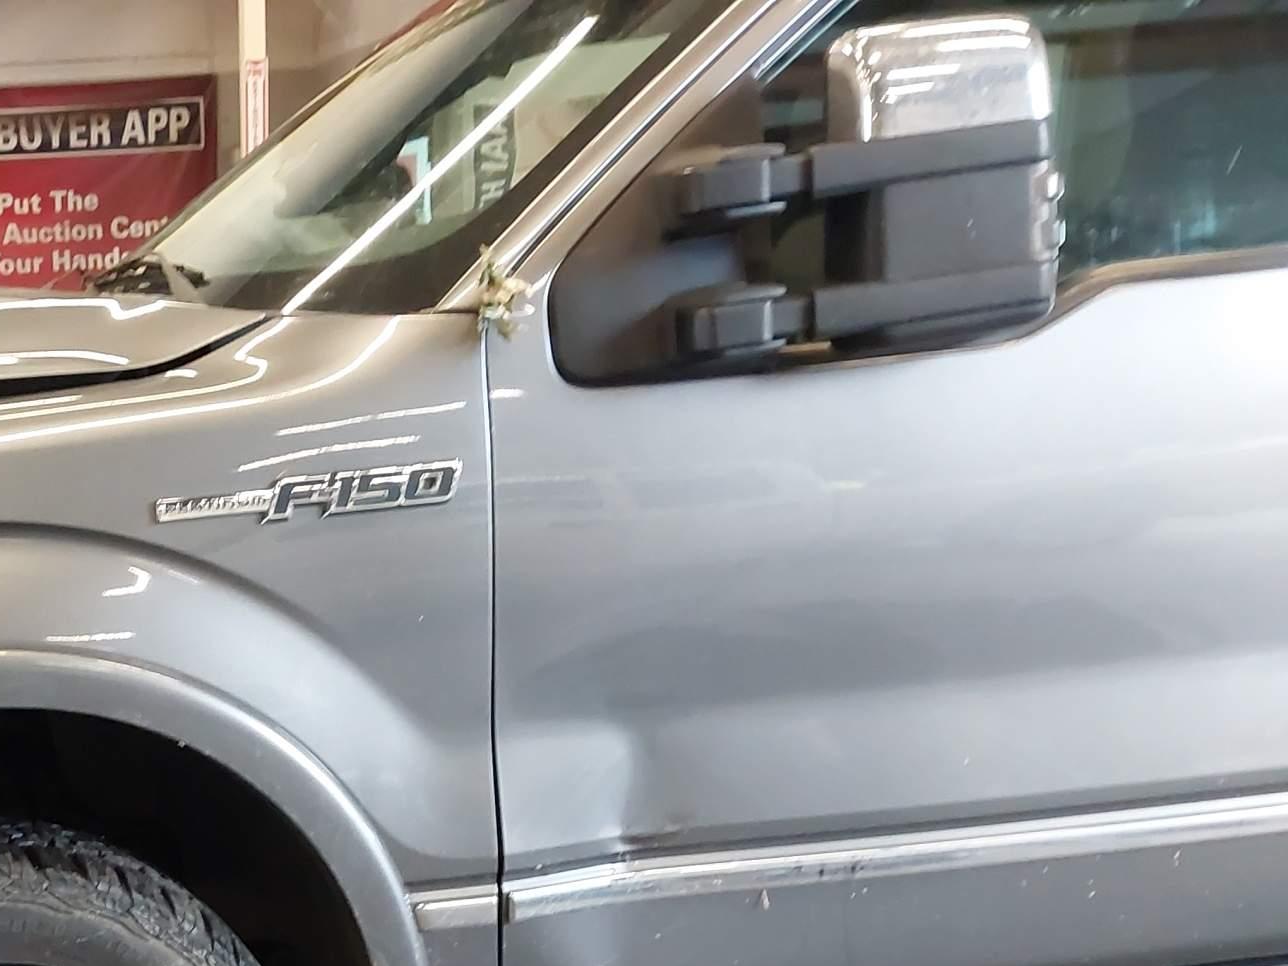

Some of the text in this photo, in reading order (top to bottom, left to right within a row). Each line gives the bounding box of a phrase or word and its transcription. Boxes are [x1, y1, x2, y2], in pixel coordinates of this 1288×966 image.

[120, 105, 191, 146] APP
[48, 189, 100, 214] The
[2, 219, 104, 247] Auction
[51, 246, 129, 272] Hand
